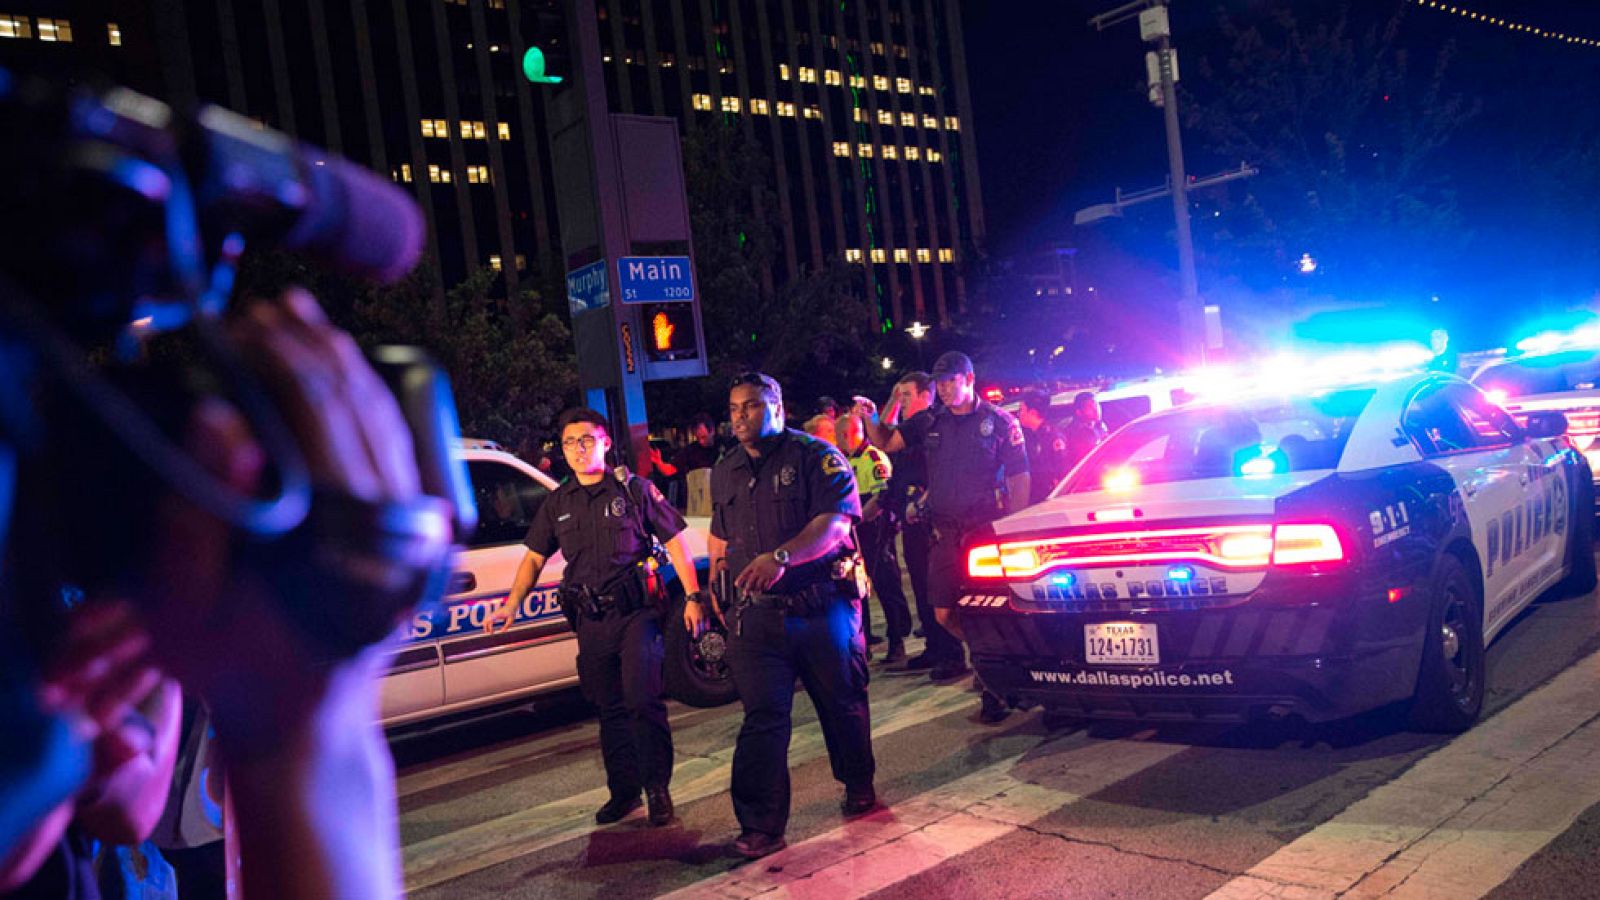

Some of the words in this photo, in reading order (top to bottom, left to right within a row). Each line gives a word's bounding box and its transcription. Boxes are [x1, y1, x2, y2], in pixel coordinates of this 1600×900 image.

[568, 266, 606, 295] Murphy
[629, 260, 682, 281] Main
[625, 288, 638, 299] St
[664, 287, 690, 297] 1200
[1486, 487, 1552, 578] POLICE
[1127, 576, 1228, 598] POLICE
[1106, 626, 1135, 635] TEXAS
[1029, 669, 1234, 689] www.dallaspolice.net
